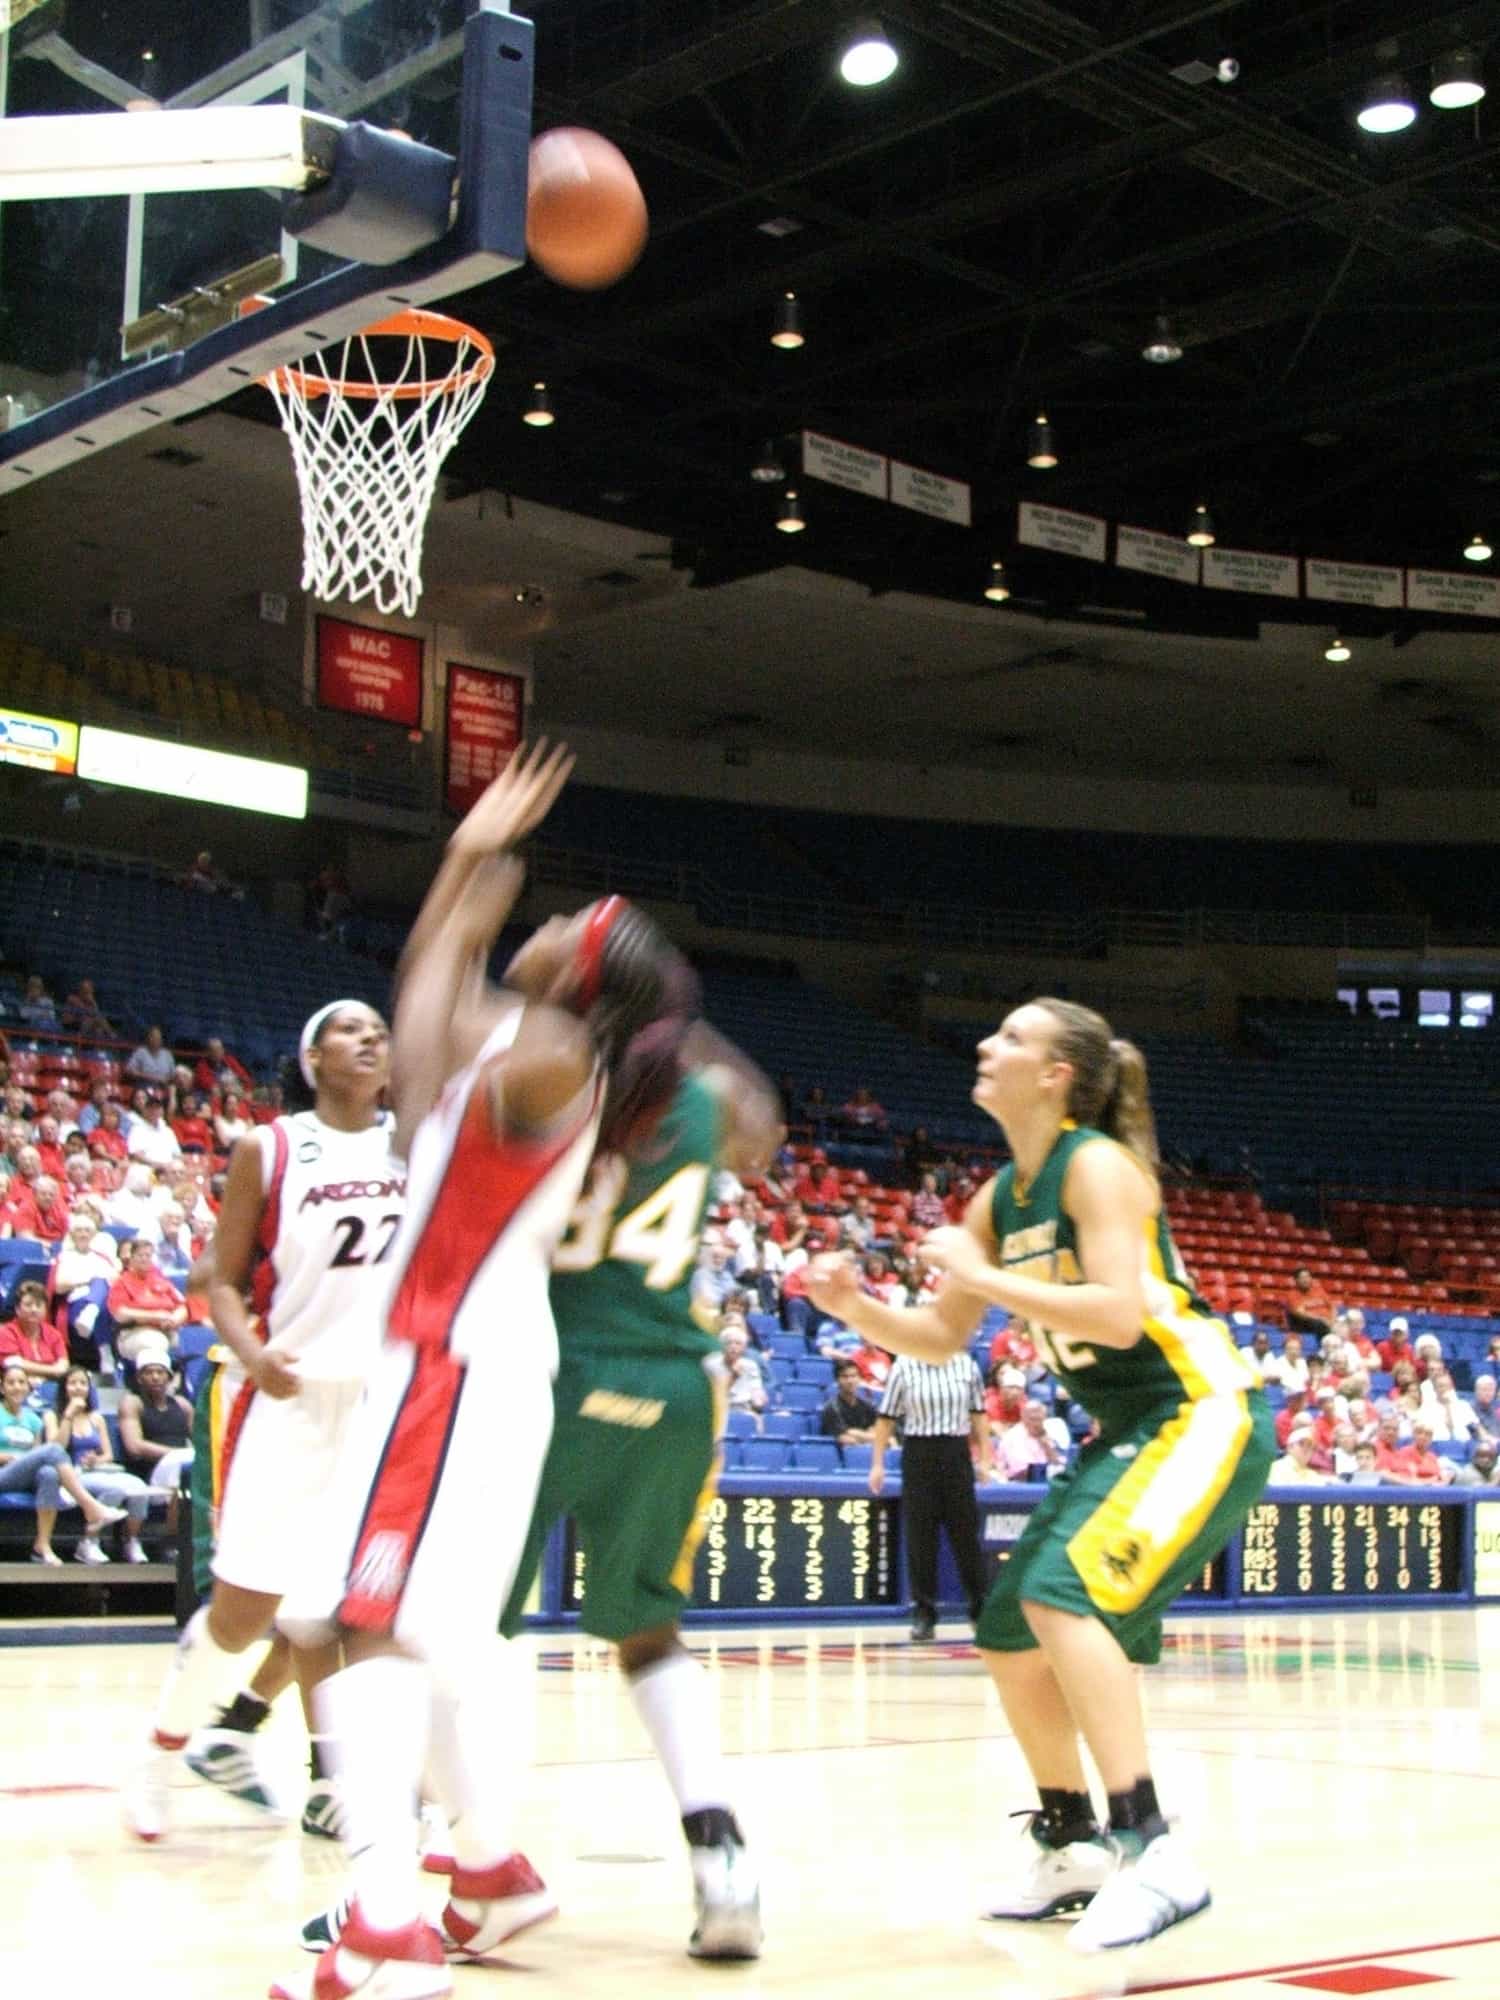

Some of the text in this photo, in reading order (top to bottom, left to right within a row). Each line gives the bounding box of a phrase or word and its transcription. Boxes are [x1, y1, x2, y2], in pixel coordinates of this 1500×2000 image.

[348, 632, 392, 659] WAC
[298, 1178, 408, 1213] ARIZON
[743, 1498, 776, 1524] 22
[791, 1499, 824, 1524] 23
[838, 1499, 870, 1524] 45
[1298, 1505, 1312, 1526] 5
[1324, 1505, 1345, 1527] 10
[1354, 1505, 1375, 1527] 21
[1387, 1505, 1410, 1527] 34
[1418, 1505, 1441, 1527] 42
[708, 1524, 870, 1550] 6 14 7 8
[1246, 1526, 1275, 1548] PTS
[1331, 1526, 1345, 1548] 2
[1365, 1527, 1378, 1548] 3
[1399, 1527, 1406, 1548] 1
[707, 1550, 870, 1576] 3 7 2 3
[1298, 1548, 1312, 1569] 2
[1331, 1548, 1345, 1569] 2
[1365, 1548, 1378, 1569] 0
[1399, 1548, 1406, 1569] 1
[1428, 1548, 1441, 1569] 5
[710, 1575, 864, 1602] 1 3 3 1
[1298, 1569, 1312, 1592] 0
[1331, 1569, 1346, 1591] 2
[1365, 1569, 1379, 1591] 0
[1397, 1569, 1411, 1590] 0
[1428, 1569, 1441, 1590] 3
